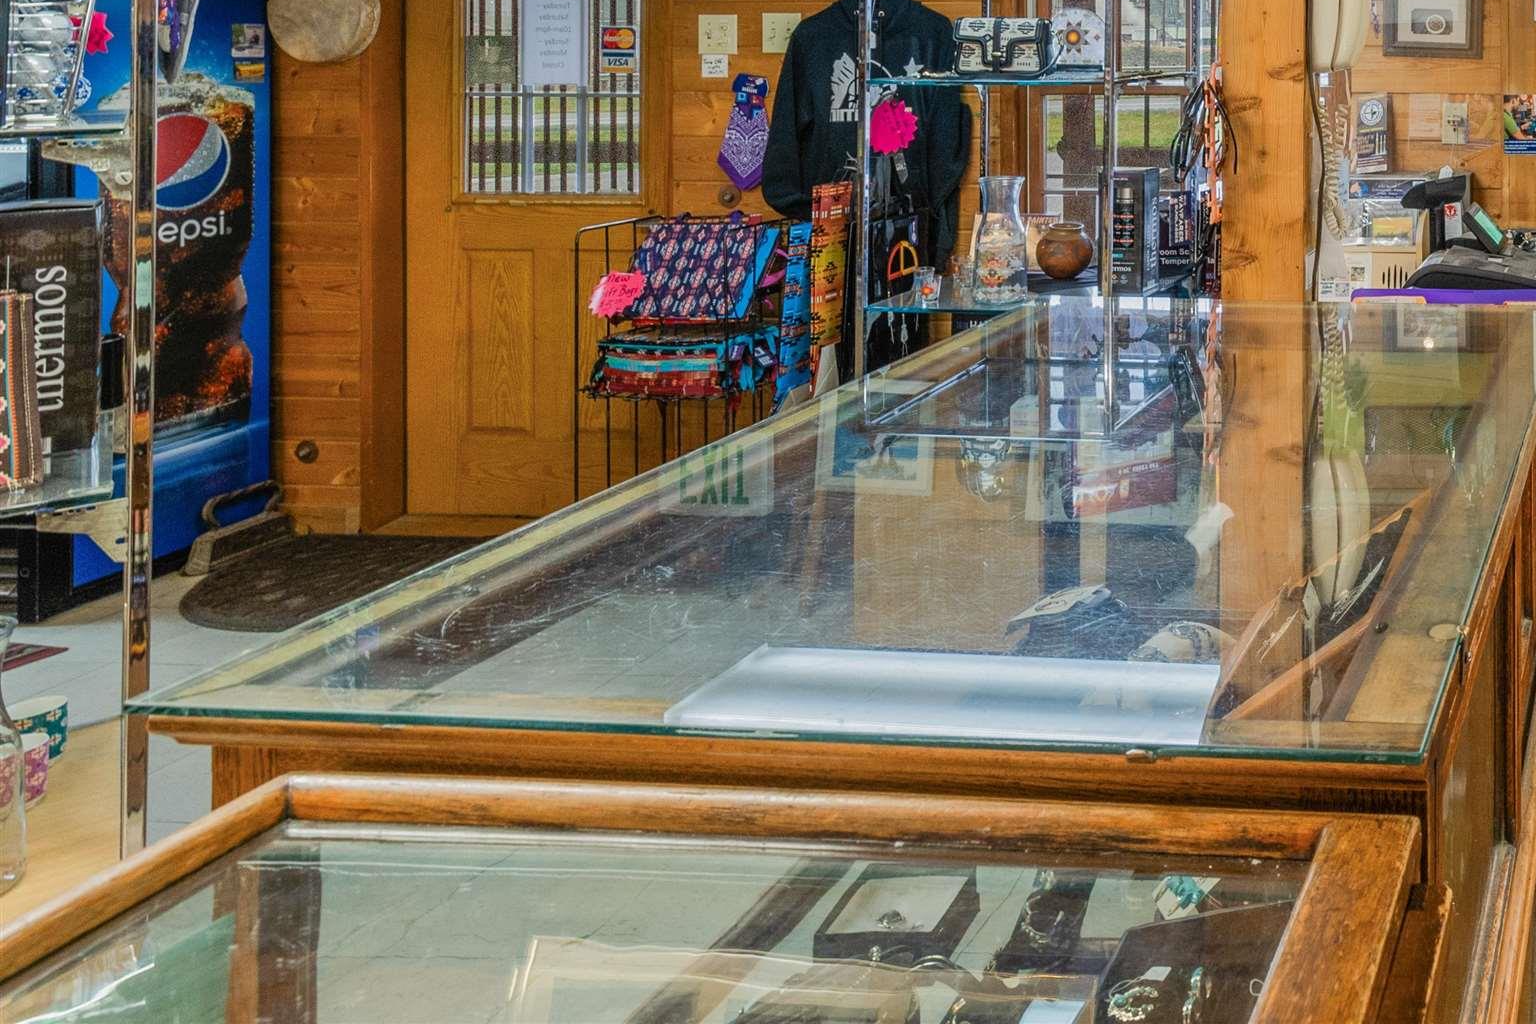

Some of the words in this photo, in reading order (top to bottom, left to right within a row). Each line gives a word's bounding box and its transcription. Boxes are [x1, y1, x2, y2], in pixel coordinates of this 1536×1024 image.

[607, 58, 629, 66] VISA
[158, 210, 224, 247] epsi
[1161, 257, 1190, 265] Temper
